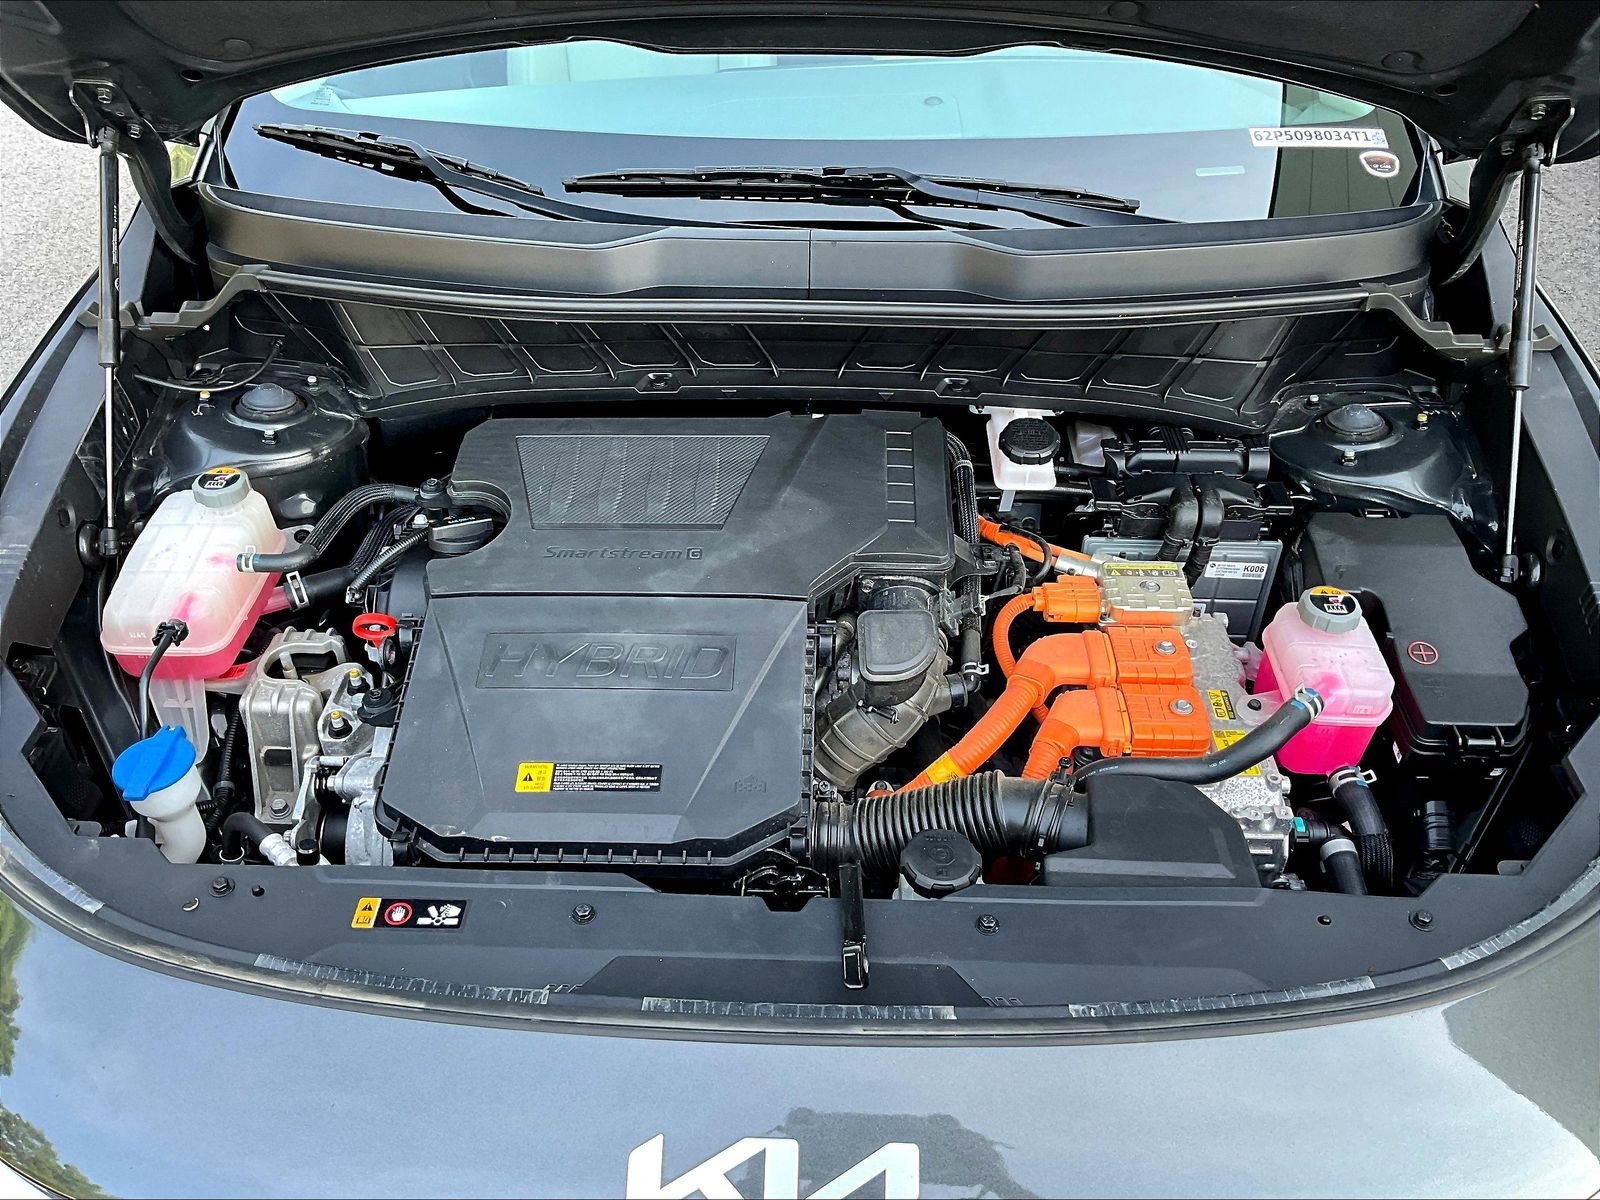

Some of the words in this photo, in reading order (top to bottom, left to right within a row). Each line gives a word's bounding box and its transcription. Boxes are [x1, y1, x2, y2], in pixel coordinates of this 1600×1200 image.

[1253, 129, 1372, 142] 62P5098034T1
[543, 545, 682, 559] Smartstream
[1243, 564, 1265, 573] K006
[483, 642, 731, 679] HYBRID
